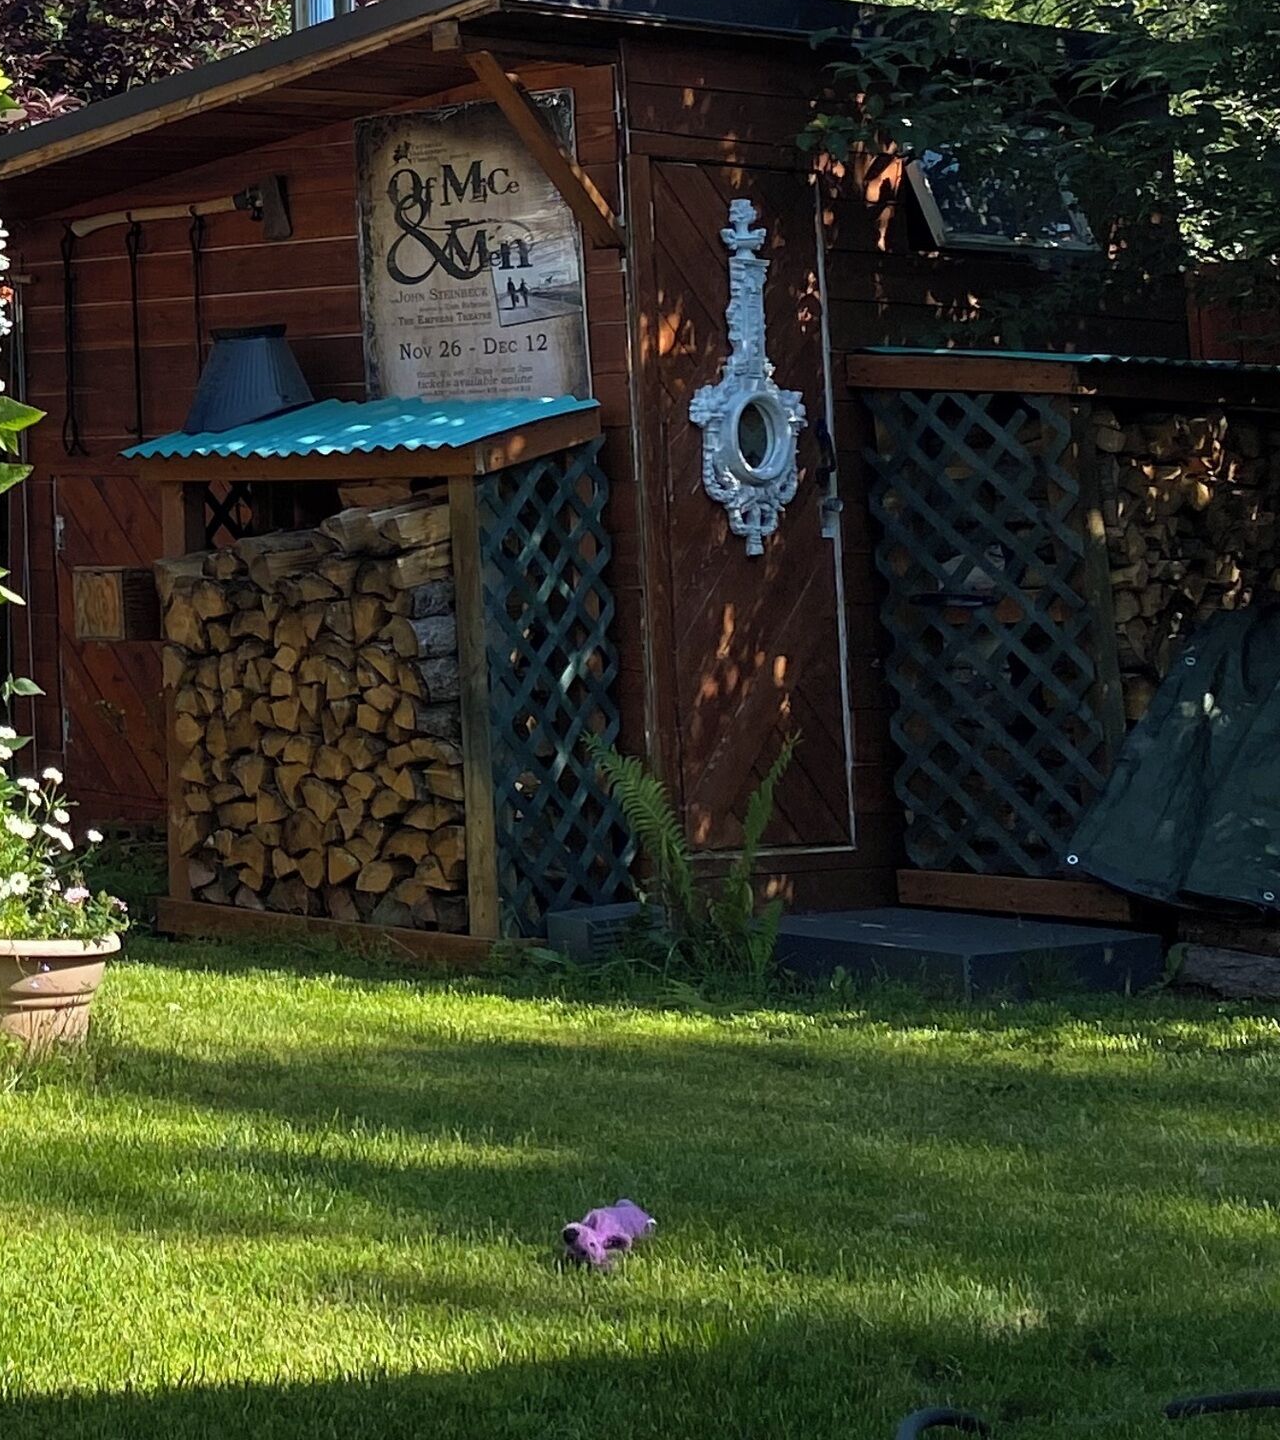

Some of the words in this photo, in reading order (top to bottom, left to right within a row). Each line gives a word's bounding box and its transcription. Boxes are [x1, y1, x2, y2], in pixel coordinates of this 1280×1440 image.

[387, 168, 437, 217] Of
[387, 194, 488, 285] &
[443, 218, 533, 271] Men
[398, 291, 425, 303] JOHN
[429, 287, 488, 301] STEINBECK
[439, 339, 462, 358] 26
[526, 334, 548, 352] 12
[417, 378, 451, 390] tickets
[453, 375, 498, 388] available
[500, 374, 533, 384] online
